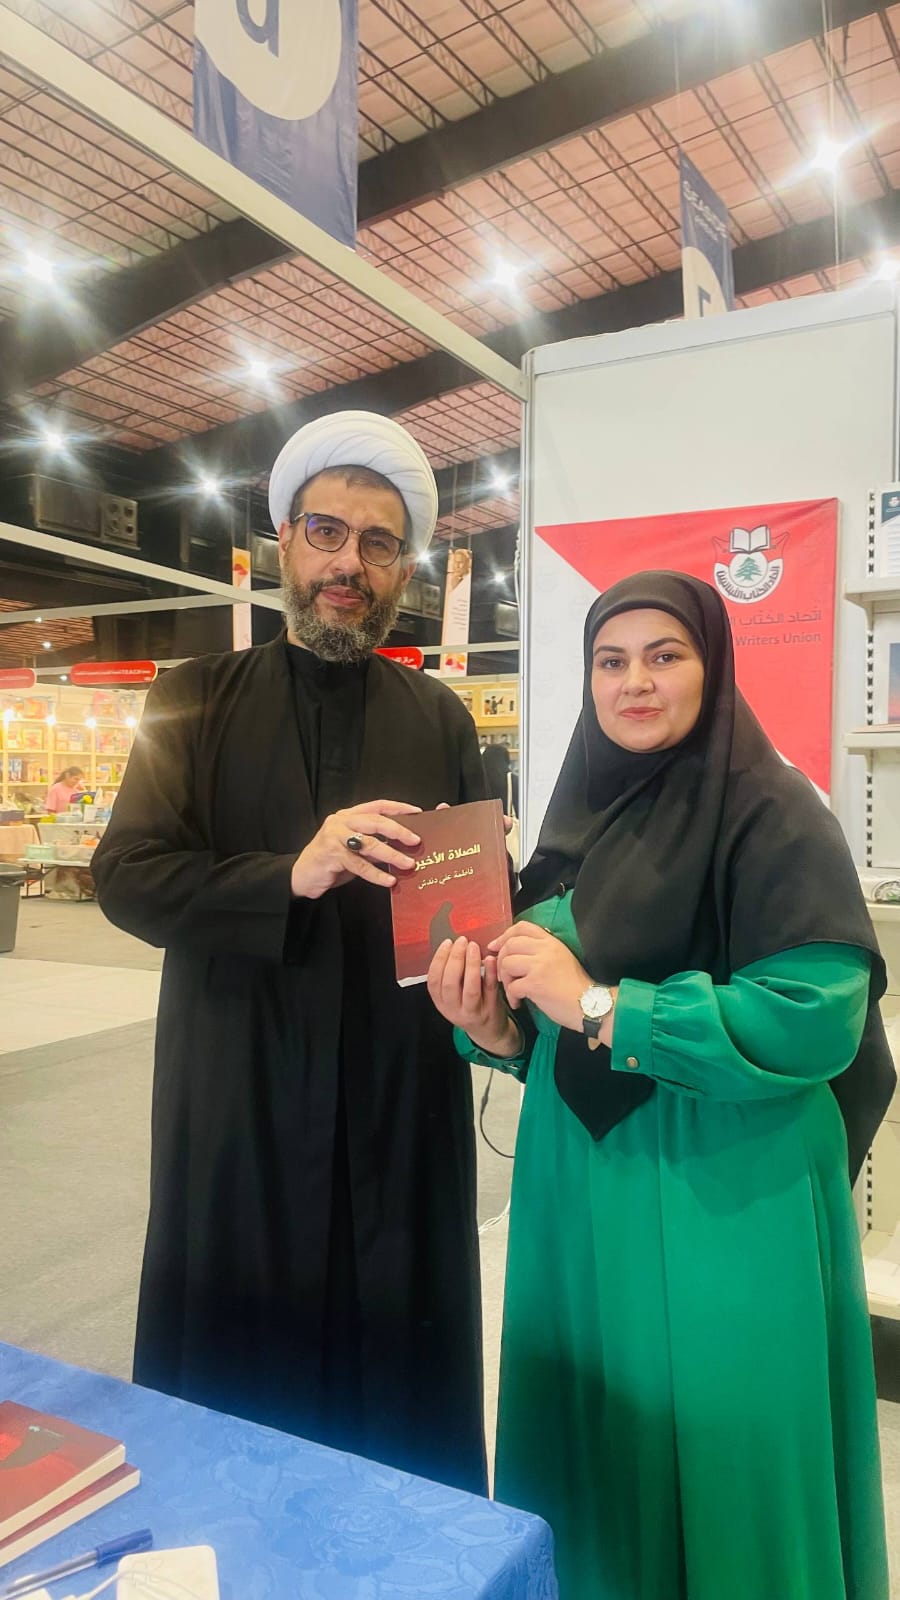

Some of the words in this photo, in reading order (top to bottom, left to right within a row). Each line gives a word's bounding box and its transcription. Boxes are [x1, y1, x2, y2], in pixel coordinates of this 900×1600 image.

[736, 635, 780, 646] Writers
[783, 632, 821, 644] Union
[447, 843, 480, 860] الصلاة
[415, 852, 445, 871] الأخير
[454, 866, 474, 878] فاطمة
[439, 874, 453, 885] علي
